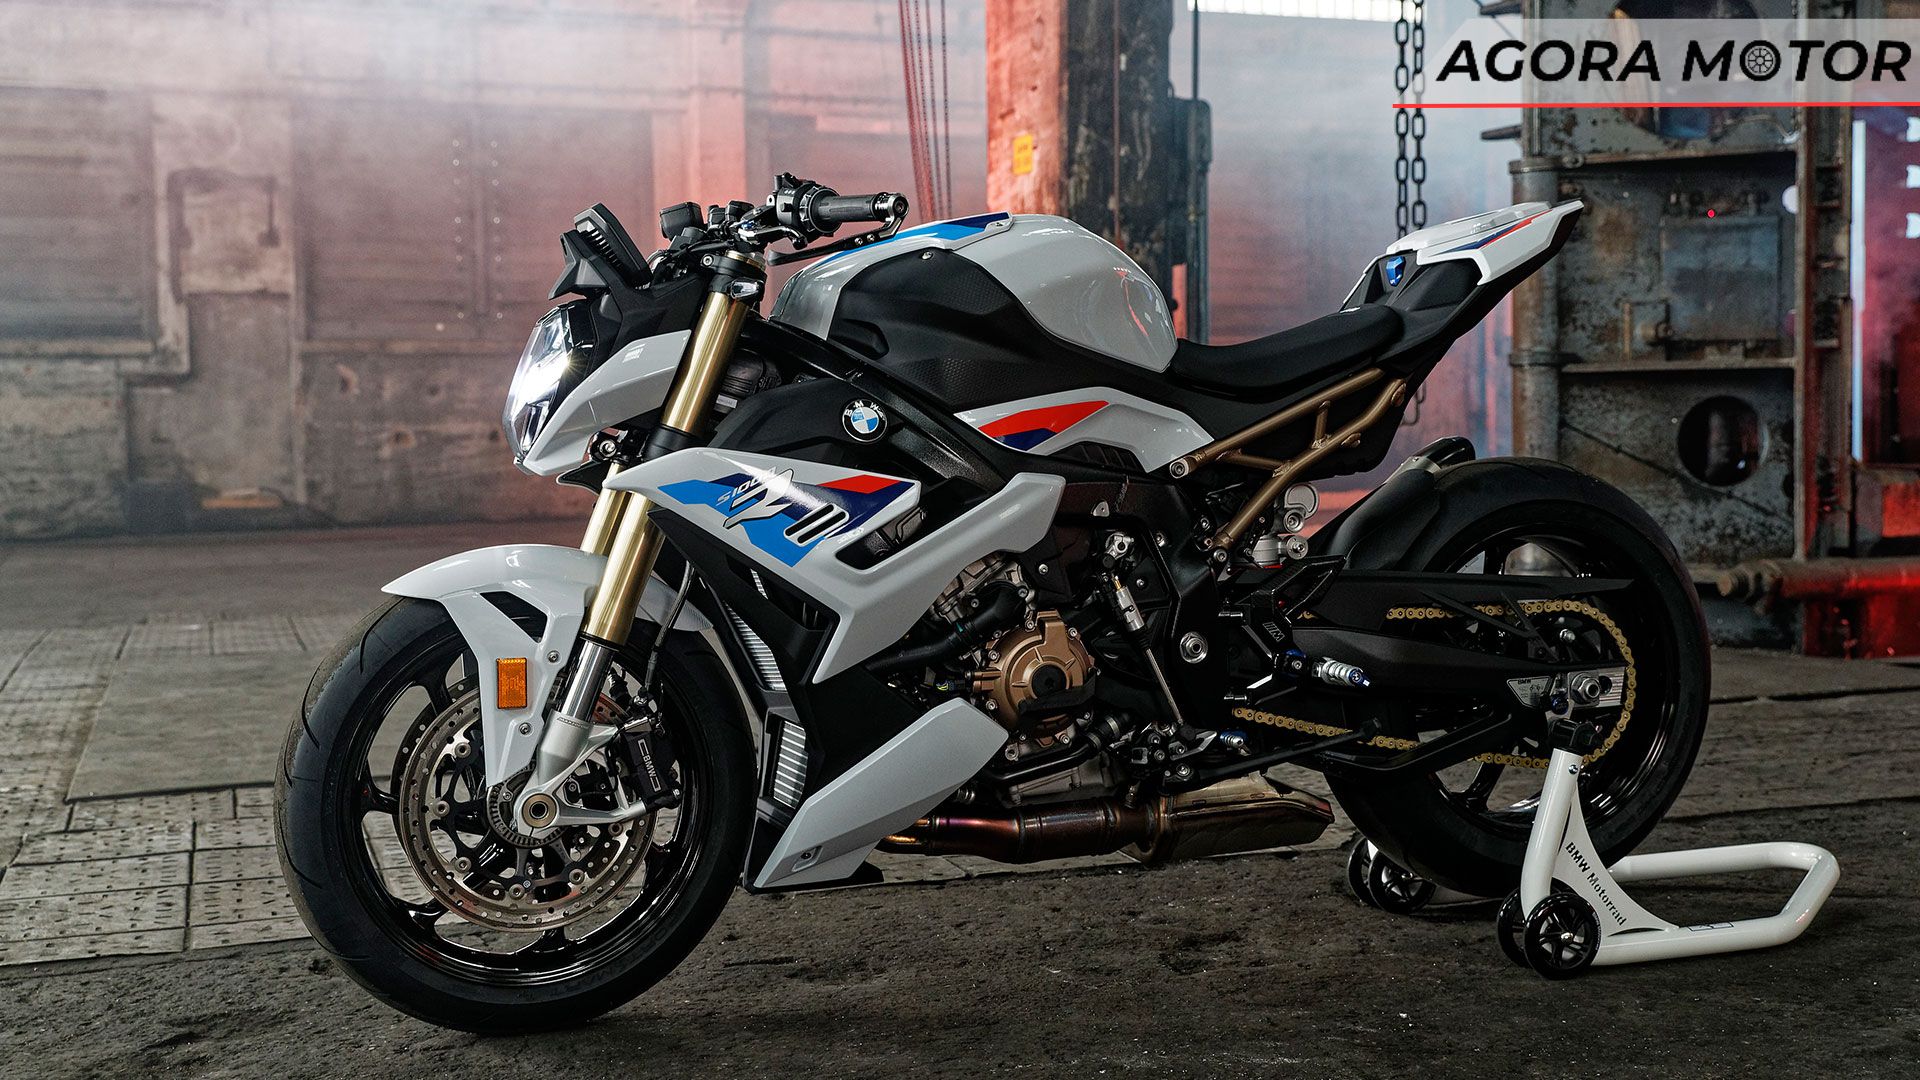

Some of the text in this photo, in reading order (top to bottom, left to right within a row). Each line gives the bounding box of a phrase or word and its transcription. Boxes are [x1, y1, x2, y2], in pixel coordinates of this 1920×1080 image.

[843, 400, 881, 417] BMW
[642, 754, 658, 779] BMW
[1565, 842, 1627, 926] BMW Motorrad
